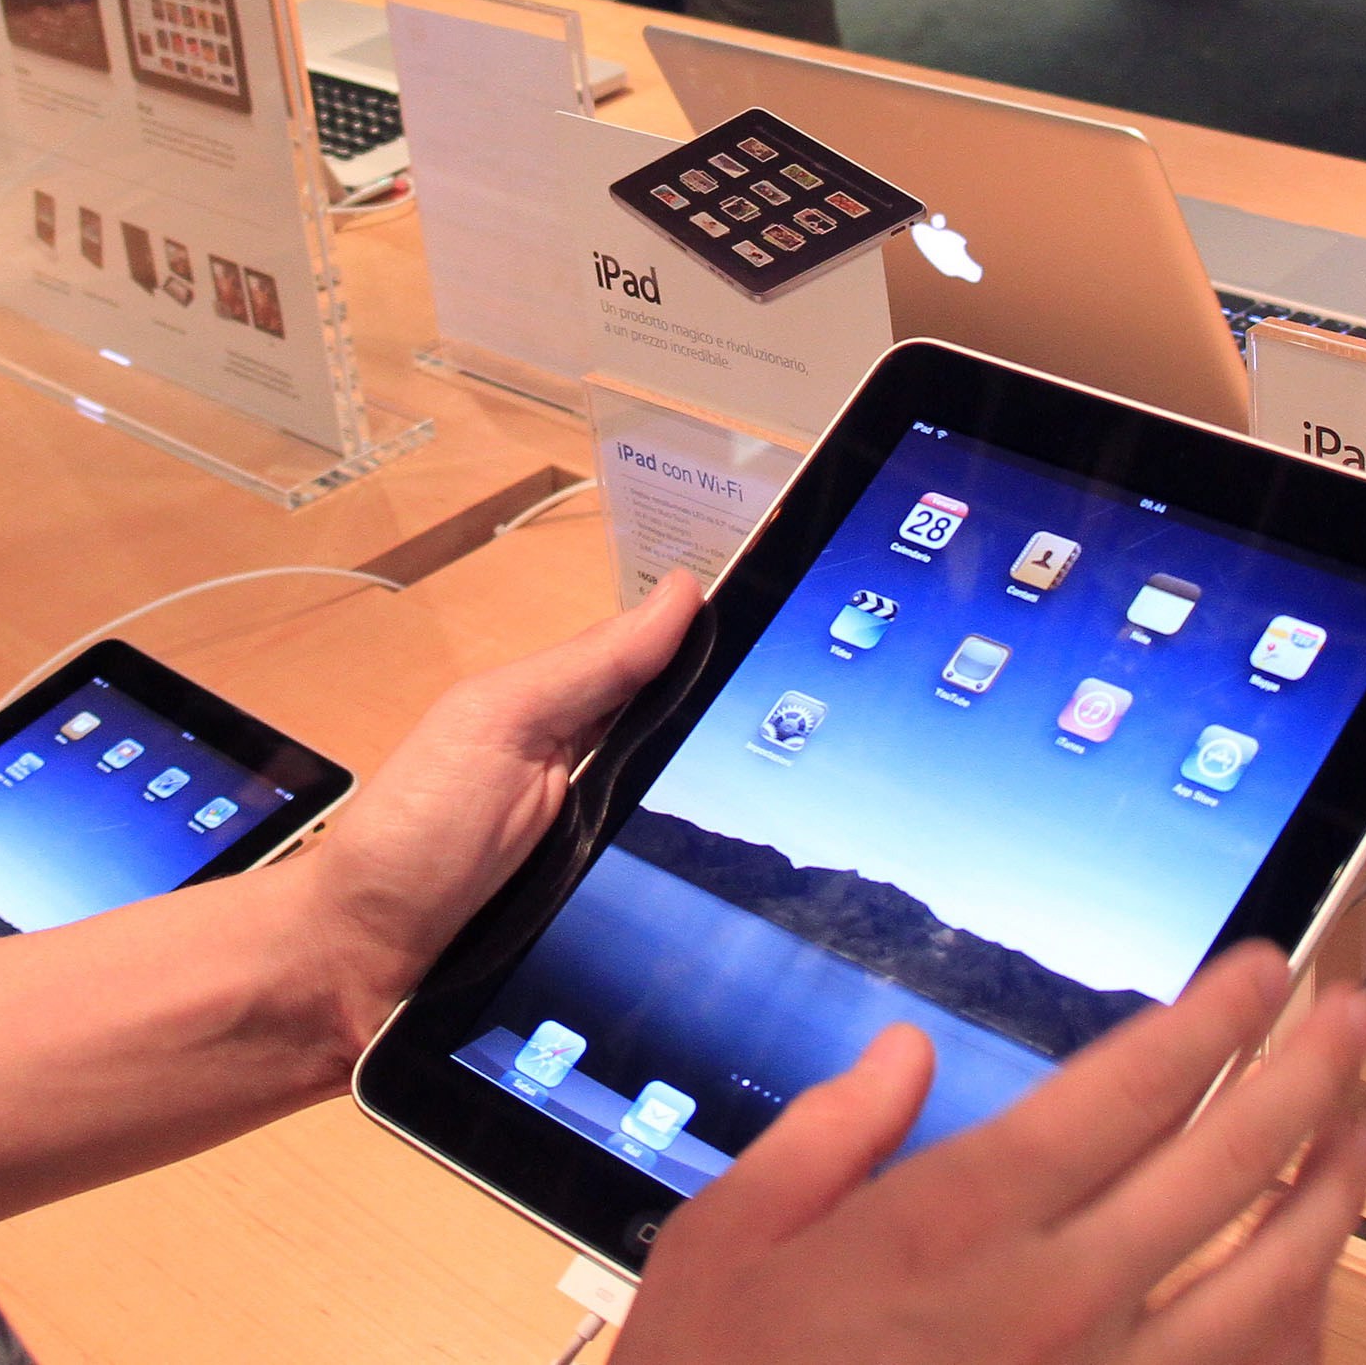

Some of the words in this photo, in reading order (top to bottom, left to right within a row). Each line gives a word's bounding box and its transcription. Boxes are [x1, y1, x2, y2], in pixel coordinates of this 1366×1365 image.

[592, 250, 662, 306] iPad
[600, 299, 618, 315] Un
[620, 306, 669, 332] prodotto
[672, 323, 714, 345] magico
[716, 338, 724, 348] e
[727, 337, 811, 377] rivoluzionario,
[603, 322, 612, 332] a
[613, 326, 629, 338] un
[631, 331, 668, 350] prezzo
[912, 420, 935, 435] iPad
[617, 442, 657, 472] iPad
[662, 462, 693, 484] con
[696, 470, 744, 503] Wi-Fi
[906, 510, 952, 542] 28
[890, 541, 932, 563] Calendario
[934, 687, 971, 709] YouTube
